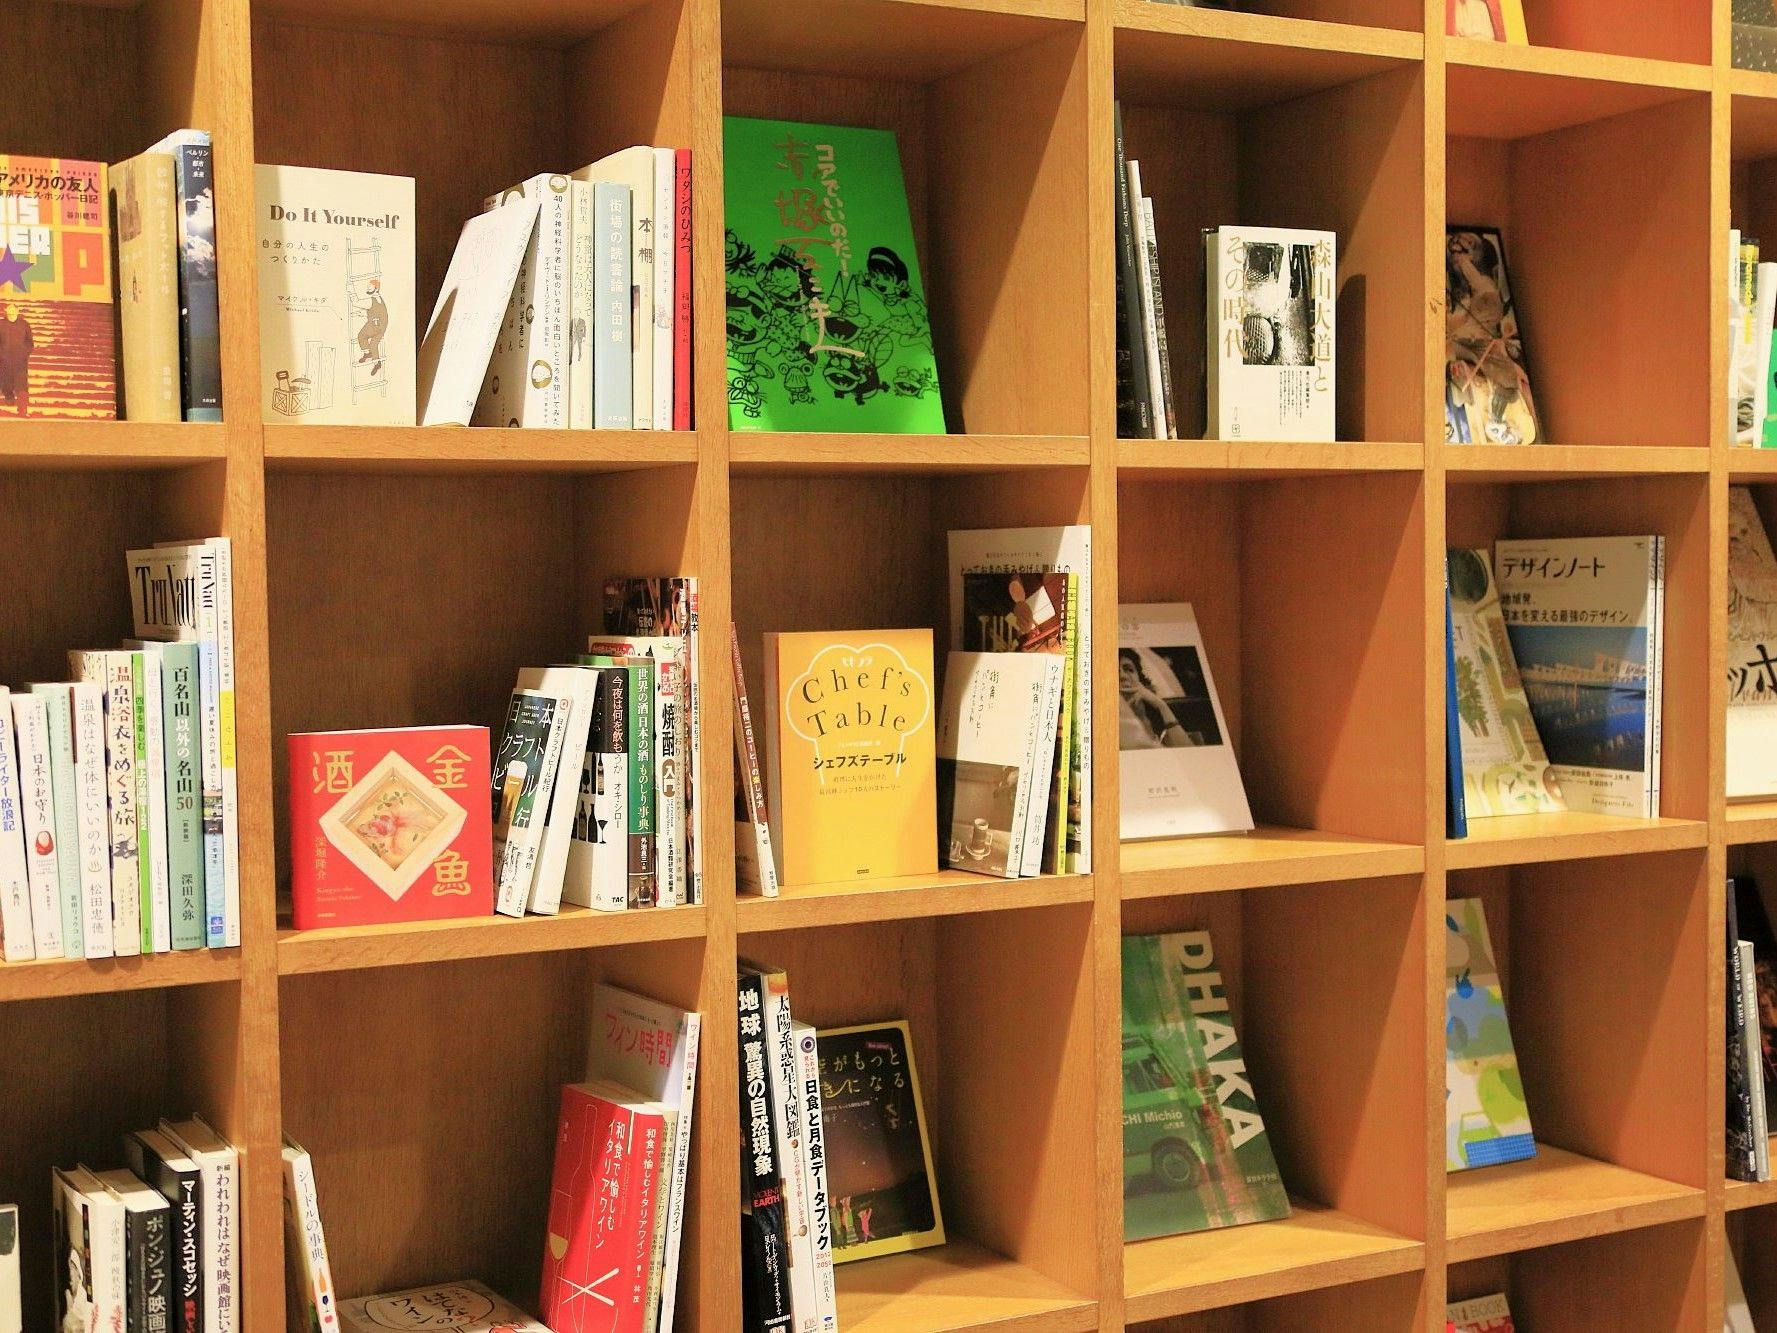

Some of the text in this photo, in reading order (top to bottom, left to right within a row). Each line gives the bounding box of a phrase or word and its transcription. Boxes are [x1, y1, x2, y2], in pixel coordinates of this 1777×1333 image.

[186, 149, 209, 157] ベルリン
[269, 204, 399, 230] Do It Yourself
[680, 168, 691, 253] ワタシのひみつ
[261, 239, 329, 252] 自分の人生の
[269, 255, 322, 266] つくりかた
[638, 217, 653, 264] 本棚
[1223, 235, 1250, 359] その時代
[1309, 239, 1332, 392] 森山大道と
[1503, 557, 1605, 578] デザインノート
[802, 666, 911, 704] Chef's
[1043, 665, 1059, 743] ウナギと日本人
[173, 666, 194, 811] 百名山以外の名山50
[612, 675, 625, 774] 今夜は何を飲もうか
[806, 702, 906, 738] Table
[312, 750, 354, 794] 酒
[426, 744, 472, 789] 金
[500, 732, 545, 762] クラフト
[813, 752, 907, 770] シェフズテーブル
[33, 753, 47, 825] 日本のお守り
[81, 697, 102, 857] 温泉はなぜ体にいいのか
[493, 763, 539, 799] ビール
[613, 783, 623, 829] オキ・シロー
[182, 874, 195, 921] 深田久弥
[431, 850, 472, 896] 魚
[605, 1012, 673, 1068] ワイン時間
[686, 1023, 698, 1070] ワイン時間
[1176, 930, 1266, 1150] DHAKA
[738, 988, 774, 1177] 地球 驚異の自然現象
[775, 995, 801, 1139] 太陽系惑星大図鑑
[1144, 1109, 1184, 1123] Michio
[595, 1118, 616, 1250] イタリアワイン
[607, 1121, 625, 1231] 和食で愉しむ
[671, 1131, 690, 1233] やっぱり基本はフランスワイン
[804, 1079, 831, 1251] 日食と月食データブック
[298, 1171, 324, 1262] シードルの事典
[635, 1128, 657, 1260] 和食で愉しむイタリアワイン
[753, 1195, 781, 1208] EARTH
[181, 1180, 198, 1297] マーティン・スコセッシ
